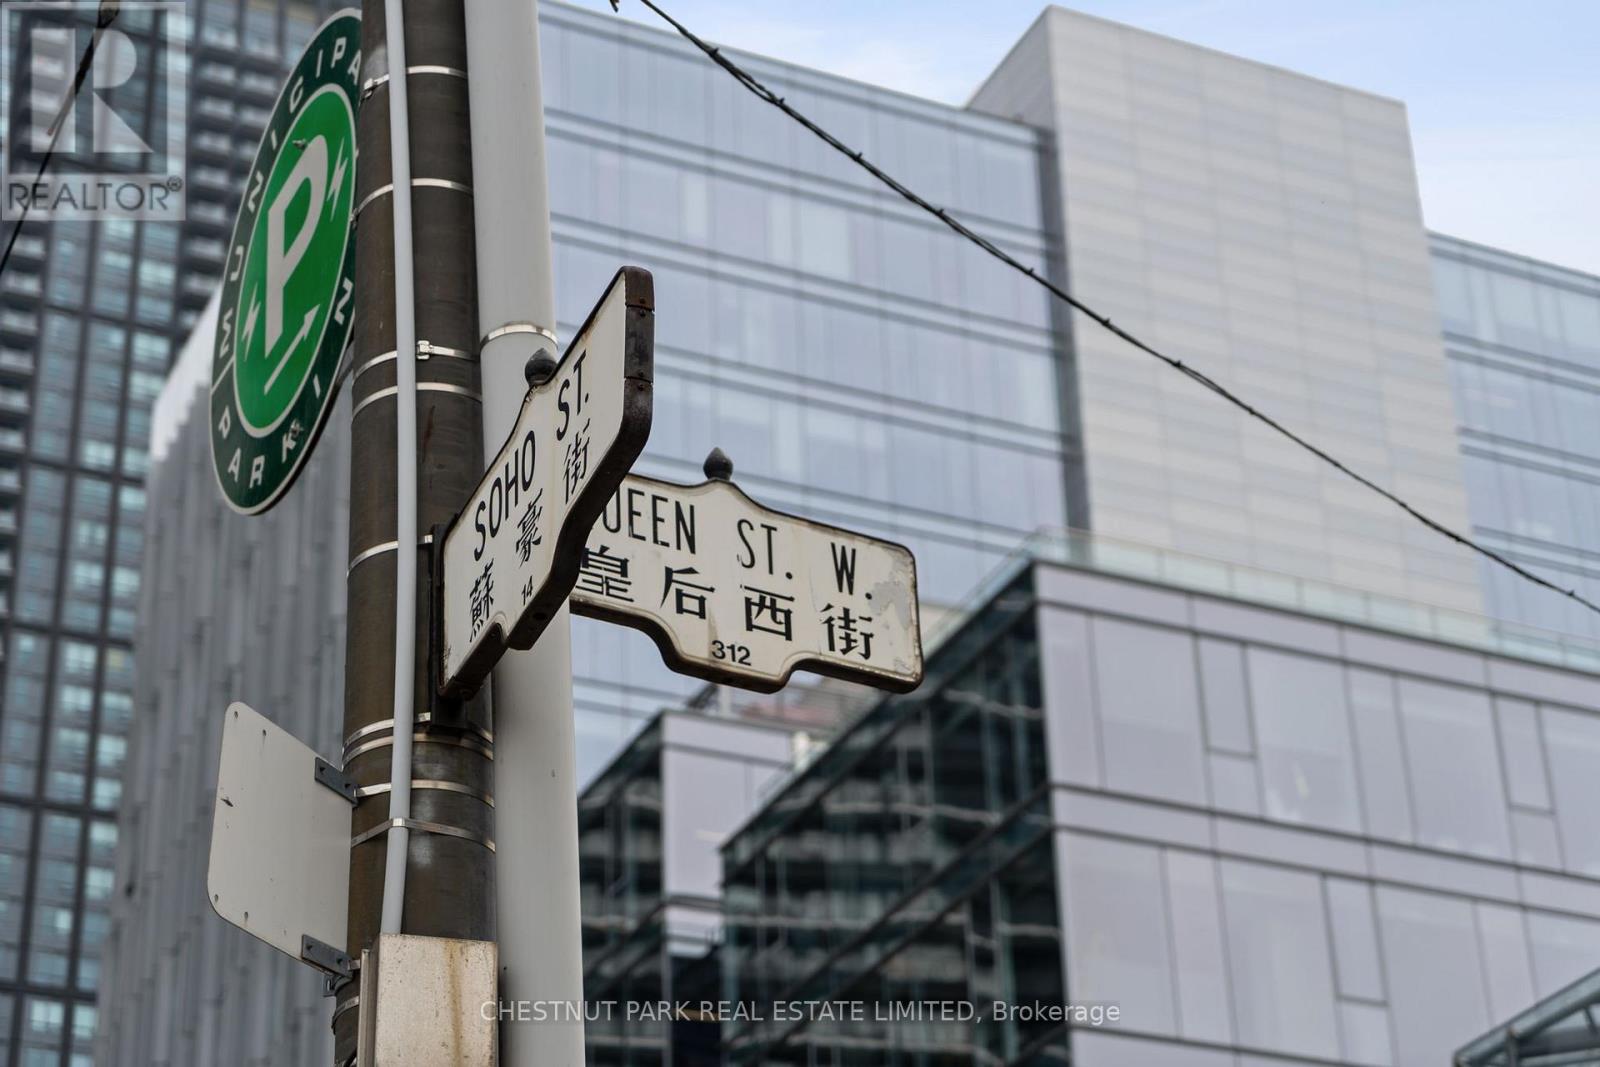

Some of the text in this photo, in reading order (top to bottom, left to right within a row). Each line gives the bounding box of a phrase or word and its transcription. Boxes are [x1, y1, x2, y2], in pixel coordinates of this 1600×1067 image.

[218, 37, 362, 359] MUNICIPA
[218, 277, 353, 489] PARKIN
[474, 350, 589, 561] SOHO ST.
[521, 575, 534, 607] 14
[601, 484, 873, 600] UEEN ST. W.
[575, 545, 875, 661] 皇后西街
[711, 639, 752, 667] 312
